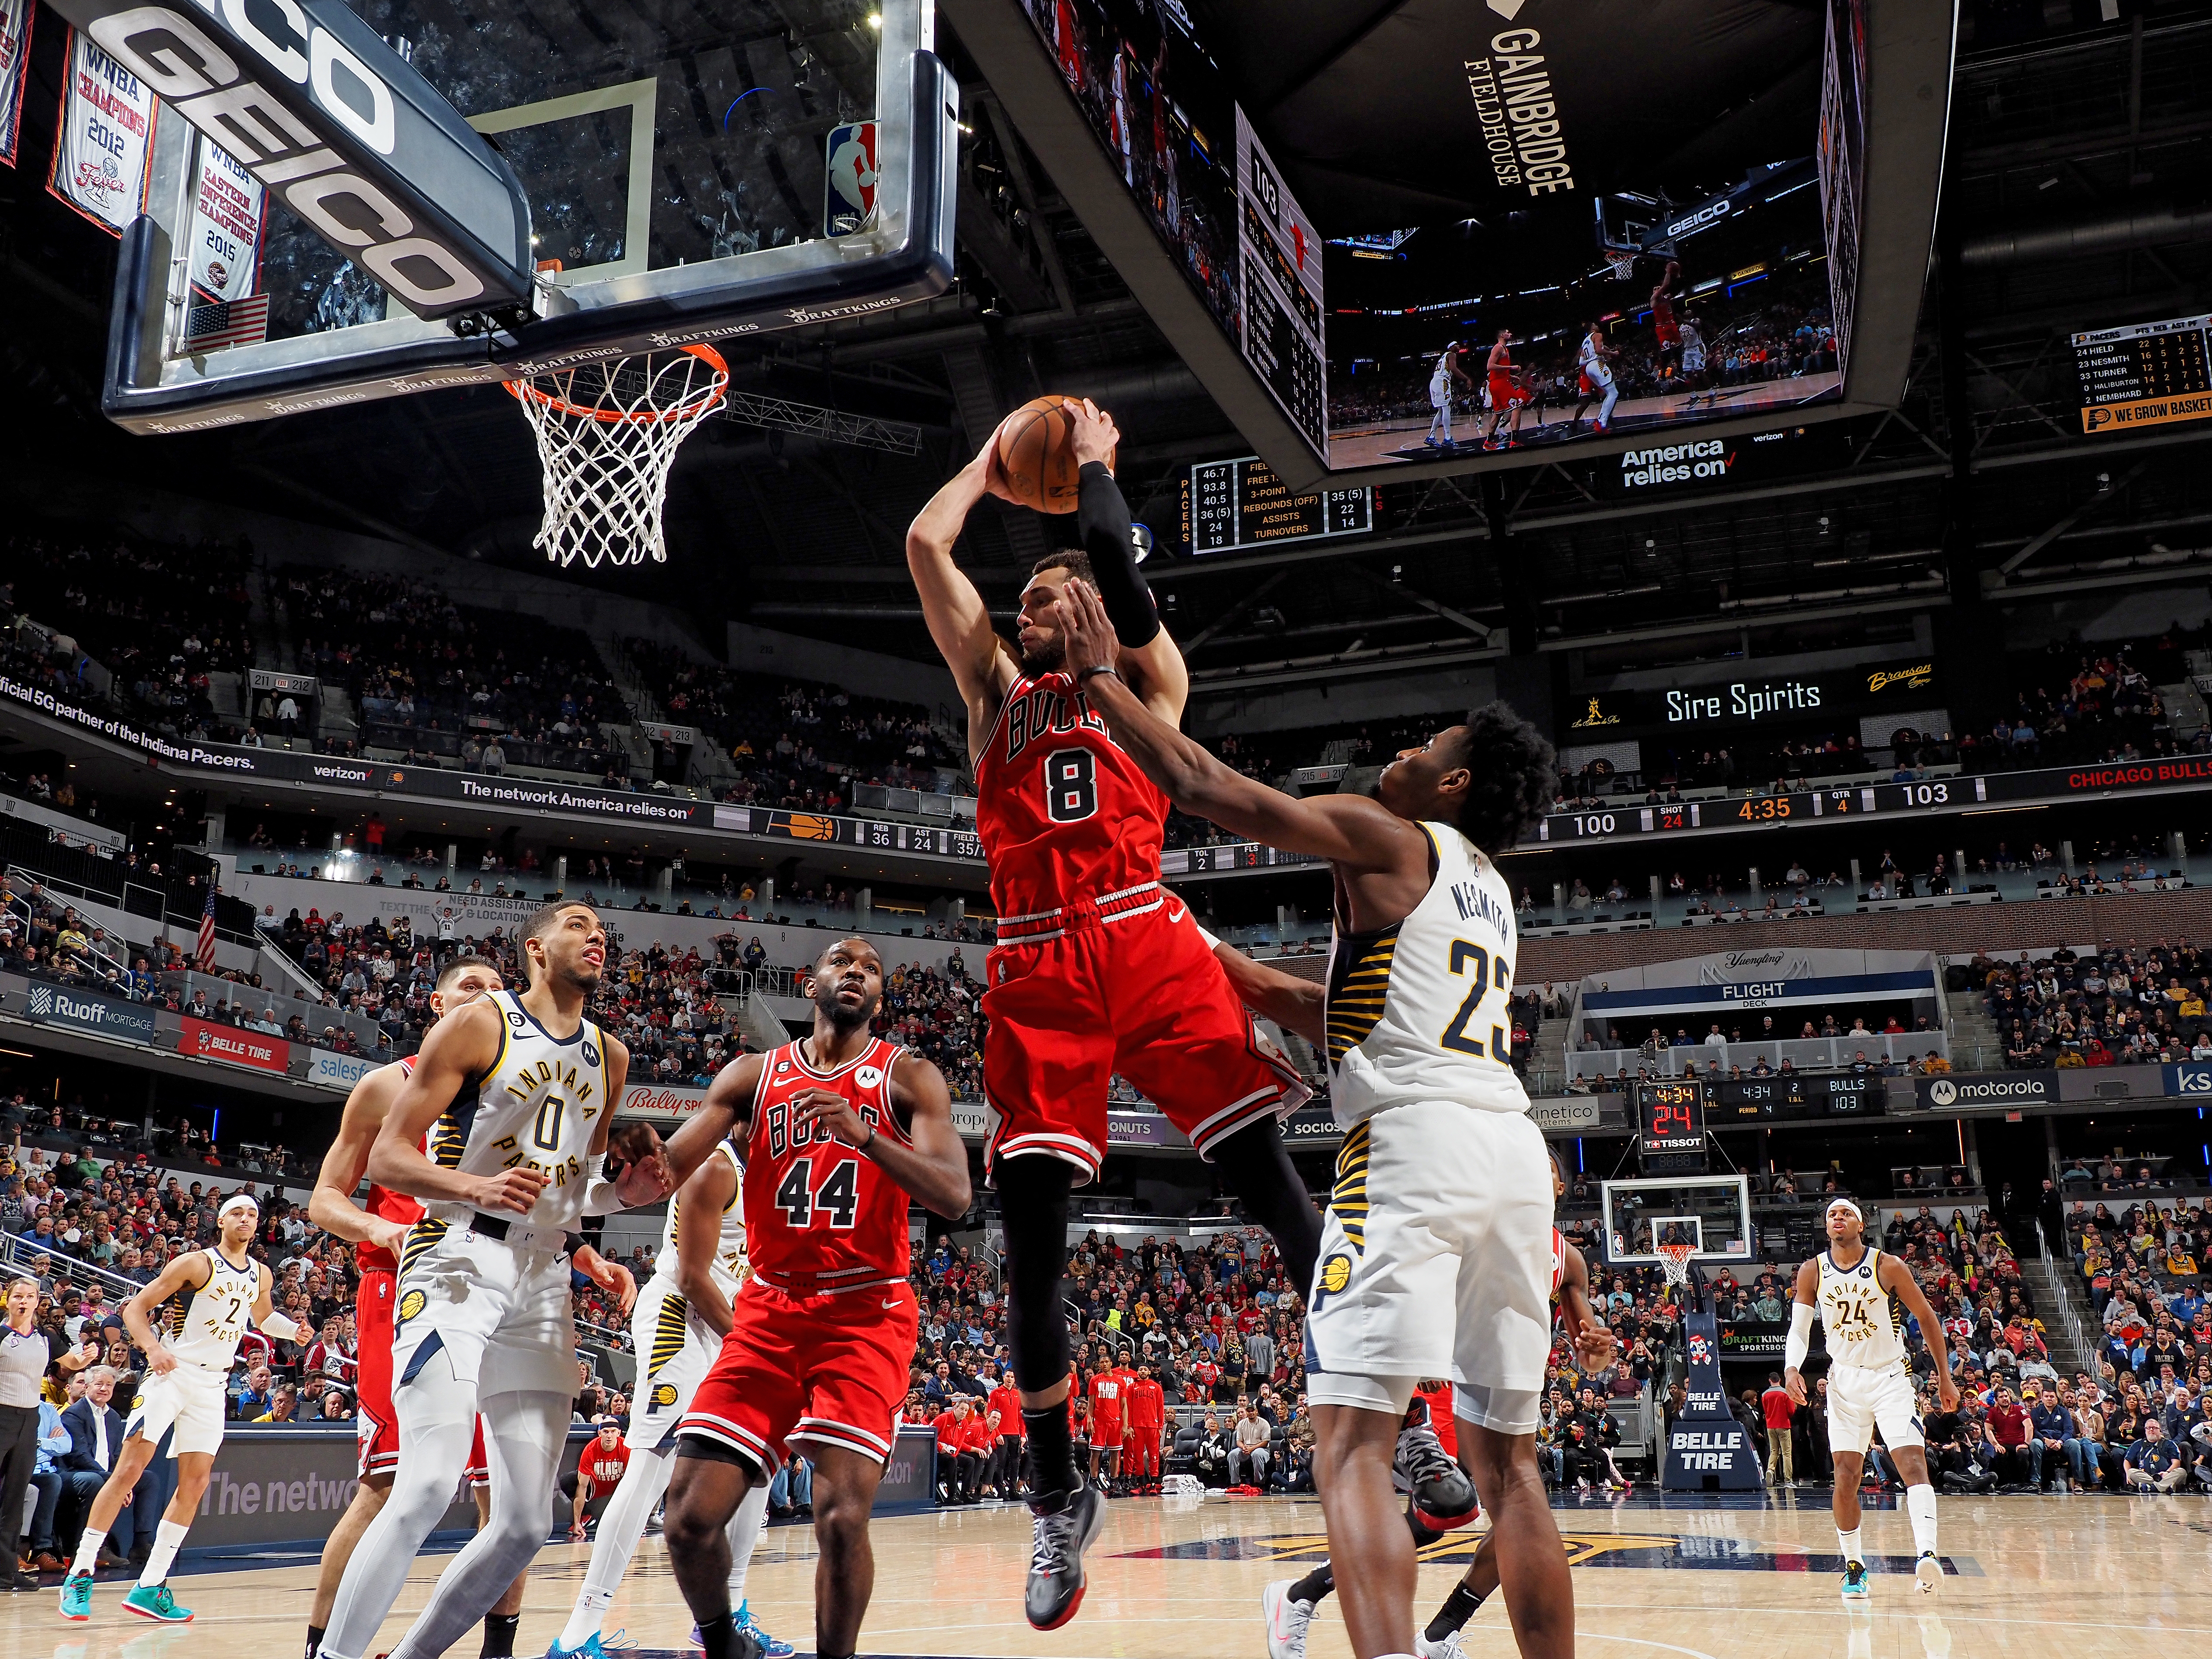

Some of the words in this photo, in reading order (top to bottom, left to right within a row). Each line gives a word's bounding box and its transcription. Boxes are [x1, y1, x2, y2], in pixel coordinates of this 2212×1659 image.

[87, 42, 140, 102] WNBA
[77, 71, 145, 138] CHAMPIONS
[1491, 28, 1574, 196] GAINBRIDGE
[1464, 58, 1521, 186] FIELDHOUSE
[88, 117, 125, 160] 2012
[89, 6, 484, 306] GEICO
[210, 142, 250, 183] WNBA
[204, 165, 251, 209] EASTERN
[1255, 158, 1276, 215] 103
[200, 181, 257, 232] ONFERENCE
[1668, 200, 1730, 236] GEICO
[207, 230, 235, 263] 2015
[793, 297, 901, 324] DRAFTKINGS
[655, 323, 759, 347] DRAFTKINGS
[2089, 345, 2114, 355] HIELD
[523, 346, 623, 375] DRAFTKINGS
[2091, 355, 2129, 367] NESMITH
[2093, 368, 2127, 379] TURNER
[396, 374, 492, 393] DRAFTKINGS
[2095, 378, 2139, 390] HALIBURTON
[274, 392, 366, 415] DRAFTKINGS
[2096, 390, 2141, 403] NEMBHARD
[2115, 408, 2133, 422] WE
[2135, 403, 2168, 419] GROW
[157, 413, 245, 434] DRAFTKINGS
[1754, 432, 1783, 442] verizon
[1622, 440, 1723, 467] America
[1203, 468, 1226, 478] 46.7
[1247, 475, 1268, 485] FREE
[1624, 463, 1691, 487] relies
[1694, 459, 1726, 477] on
[1203, 482, 1226, 492] 93.8
[1331, 491, 1345, 501] 35
[1348, 489, 1362, 501] (5)
[1204, 495, 1226, 506] 40.5
[1244, 499, 1292, 513] REBOUNDS
[1295, 496, 1318, 508] (OFF)
[1341, 504, 1354, 514] 22
[1201, 510, 1213, 520] 36
[1216, 507, 1230, 519] (5)
[1263, 513, 1299, 523] ASSISTS
[1342, 518, 1354, 527] 14
[1209, 522, 1222, 532] 24
[1254, 525, 1308, 538] TURNOVERS
[1210, 535, 1222, 546] 18
[255, 675, 269, 686] 211
[292, 680, 309, 691] 212
[1867, 663, 1931, 692] Branson
[1667, 690, 1720, 722] Sire
[1730, 682, 1820, 719] Spirits
[0, 675, 32, 702] ficial
[33, 691, 54, 712] 5G
[55, 702, 105, 730] partner
[105, 720, 120, 736] of
[120, 724, 139, 744] the
[141, 731, 189, 761] Indiana
[191, 747, 255, 770] Pacers.
[1006, 688, 1107, 764] BULL
[675, 730, 689, 741] 213
[314, 766, 365, 781] verizon
[1301, 771, 1314, 781] 215
[2069, 766, 2153, 788] CHICAGO
[2158, 761, 2212, 780] BULLS
[1044, 746, 1098, 823] 8
[461, 781, 491, 797] The
[494, 788, 558, 805] network
[560, 793, 624, 813] America
[625, 802, 666, 817] relies
[668, 808, 688, 819] on
[1902, 784, 1948, 805] 103
[1739, 798, 1790, 820] 4:35
[1837, 799, 1847, 812] 4
[1575, 815, 1615, 835] 100
[1663, 815, 1682, 828] 24
[872, 833, 889, 845] 36
[914, 838, 931, 850] 24
[1198, 858, 1206, 870] 2
[1247, 854, 1256, 865] 3
[380, 901, 407, 912] TEXT
[410, 904, 429, 914] THE
[449, 895, 478, 906] NEED
[1451, 881, 1508, 947] NESMITH
[1725, 951, 1785, 969] Yuengling
[1723, 982, 1785, 999] FLIGHT
[1440, 938, 1513, 1071] 23
[1743, 999, 1767, 1008] DECK
[55, 995, 106, 1022] Ruoff
[105, 1013, 152, 1031] MORTGAGE
[211, 1037, 245, 1055] BELLE
[247, 1043, 272, 1061] TIRE
[320, 1057, 369, 1082] salesf
[506, 1060, 597, 1122] INDIANA
[1707, 1088, 1712, 1097] 2
[1743, 1086, 1771, 1098] 4:34
[1792, 1083, 1798, 1093] 2
[1830, 1079, 1865, 1091] BULLS
[1960, 1079, 2044, 1098] motorola
[627, 1088, 682, 1115] Bally
[1657, 1088, 1693, 1103] 4:34
[1835, 1096, 1857, 1109] 103
[534, 1094, 565, 1152] 0
[1108, 1122, 1151, 1134] ONUTS
[1654, 1105, 1691, 1134] 24
[1660, 1138, 1702, 1148] TISSOT
[775, 1158, 859, 1229] 44
[1824, 1283, 1878, 1307] INDIANA
[225, 1298, 241, 1324] 2
[1837, 1300, 1867, 1325] 24
[204, 1319, 244, 1342] PACERS
[1833, 1322, 1878, 1341] PACERS
[1723, 1335, 1786, 1345] DRAFTKING
[1688, 1392, 1721, 1401] BELLE
[1691, 1402, 1716, 1411] TIRE
[1672, 1432, 1741, 1449] BELLE
[1681, 1452, 1733, 1470] TIRE
[200, 1472, 261, 1515] The
[266, 1473, 359, 1513] netwo
